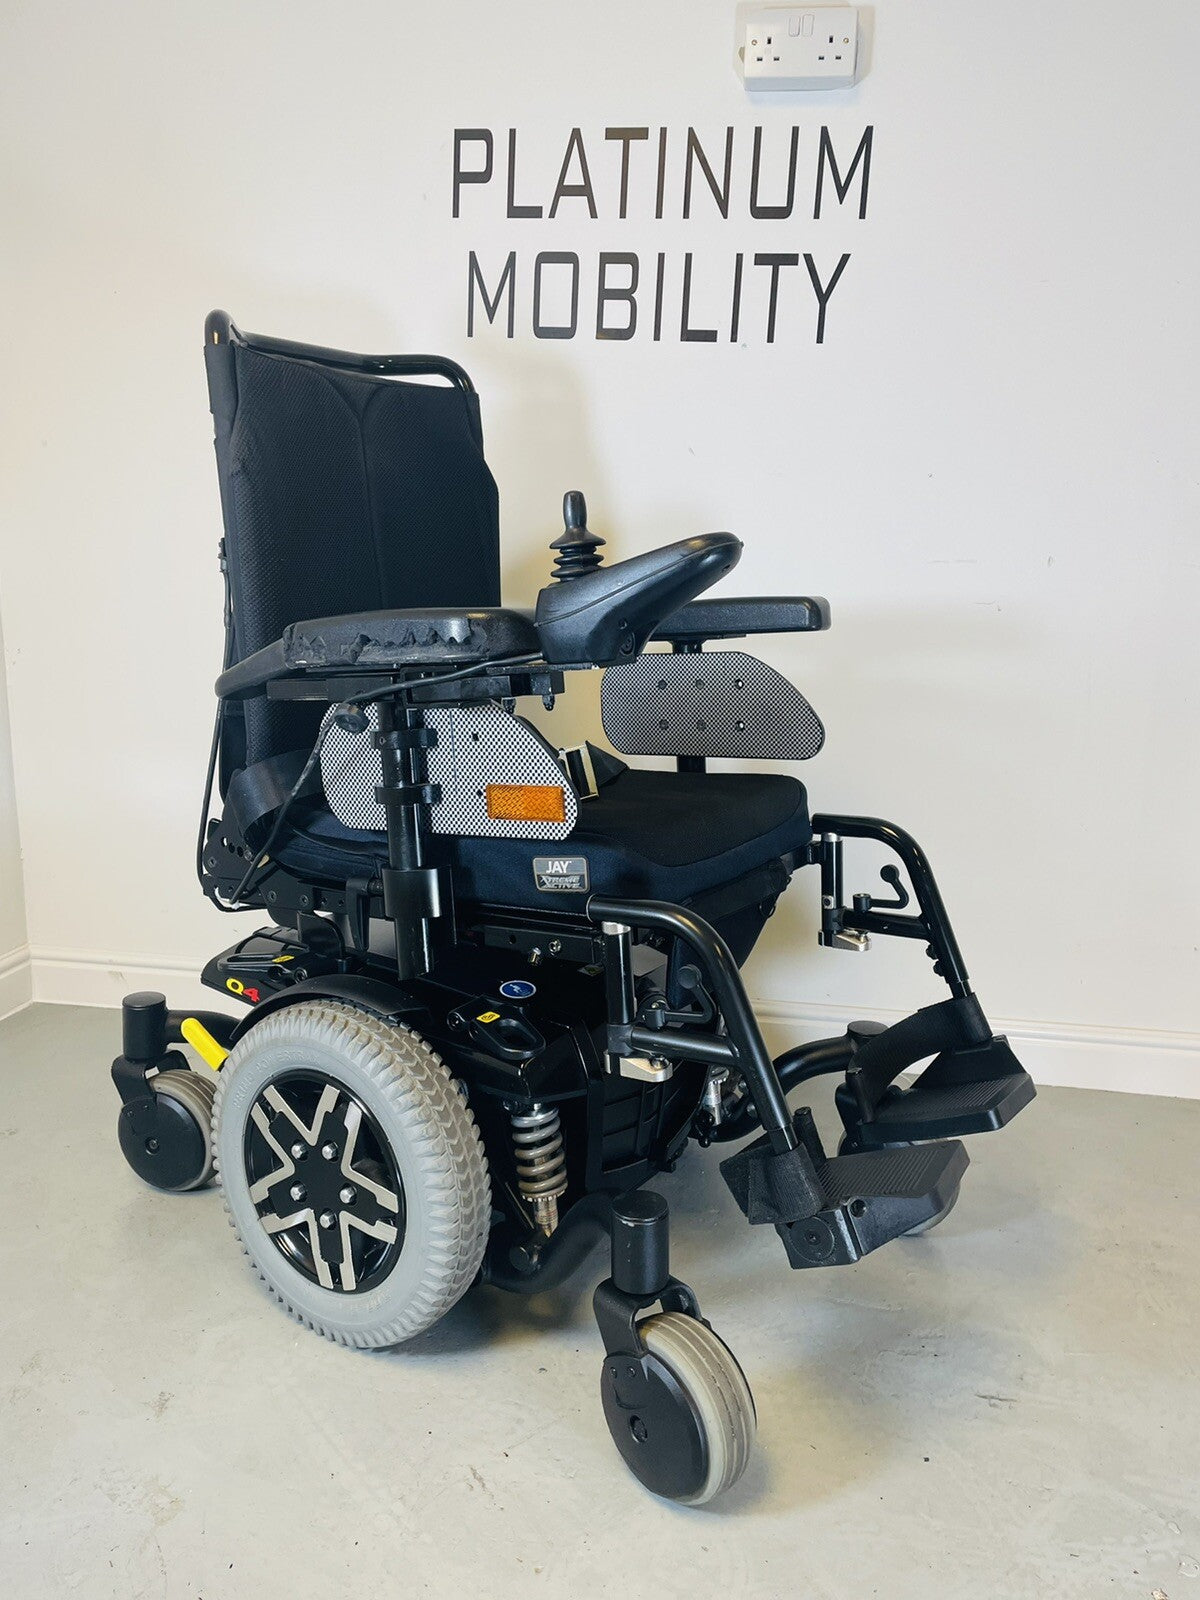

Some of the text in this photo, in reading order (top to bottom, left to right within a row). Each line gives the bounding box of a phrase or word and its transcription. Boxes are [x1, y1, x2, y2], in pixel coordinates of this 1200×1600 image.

[452, 125, 874, 220] PLATINUM
[466, 250, 852, 345] MOBILITY
[545, 860, 569, 874] JAY
[225, 977, 260, 1003] Q4
